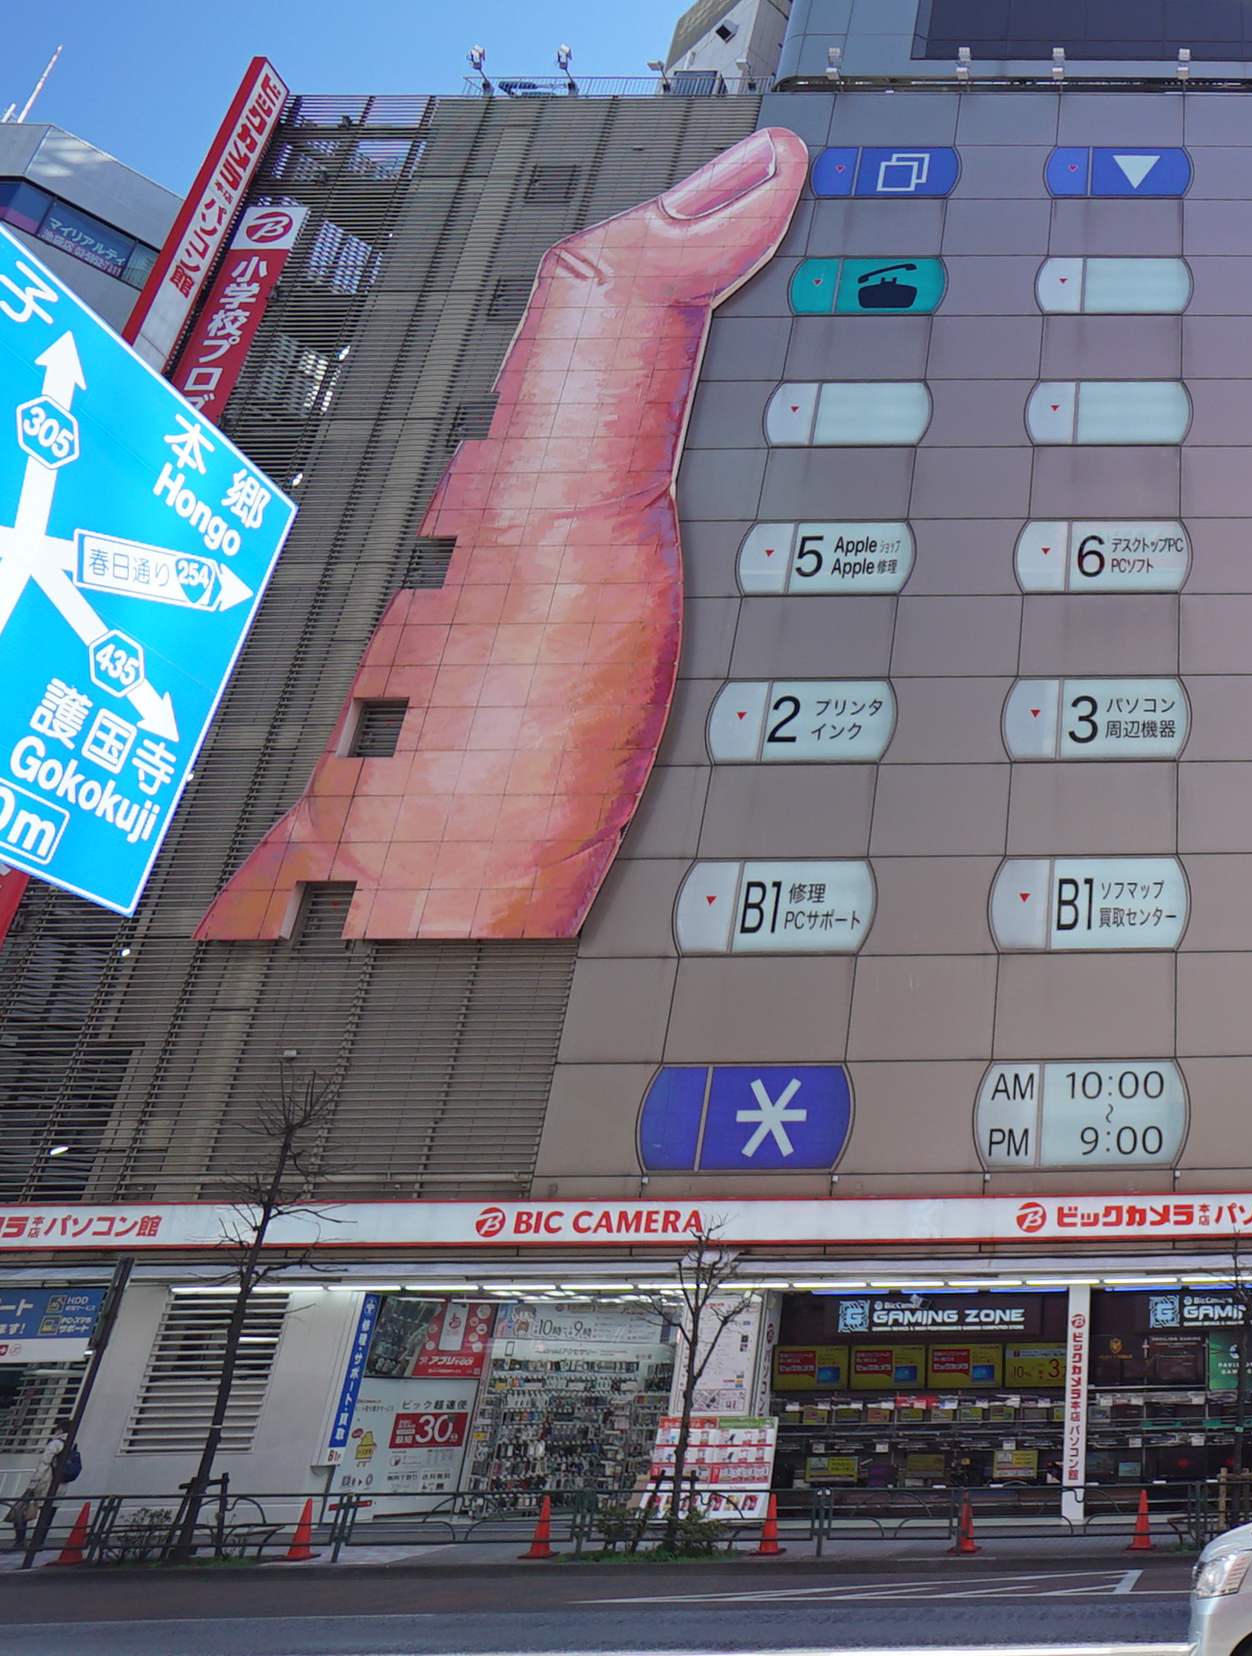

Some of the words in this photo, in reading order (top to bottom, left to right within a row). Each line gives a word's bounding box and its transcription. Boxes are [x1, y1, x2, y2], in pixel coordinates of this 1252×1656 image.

[49, 217, 127, 266] マイリアルティ
[23, 406, 73, 459] 305
[164, 413, 271, 529] 本郷
[153, 462, 241, 556] Hongo
[795, 536, 825, 577] 5
[834, 536, 878, 557] Apple
[1077, 535, 1105, 577] 6
[1111, 538, 1184, 553] デスクトップPC
[89, 549, 170, 588] 春日通り
[177, 560, 210, 589] 254
[831, 558, 875, 579] Apple
[1111, 558, 1154, 574] PCソフト
[95, 644, 140, 685] 435
[766, 696, 800, 743] 2
[816, 698, 883, 717] プリンタ
[1068, 695, 1098, 743] 3
[1106, 698, 1175, 714] パソコン
[30, 678, 177, 796] 護国寺
[811, 723, 862, 741] インク
[1105, 720, 1176, 739] 周辺機器
[10, 736, 160, 843] Gokokuji
[788, 883, 826, 904] 修理
[1056, 878, 1094, 931] B1
[1101, 880, 1165, 900] ソフマップ
[739, 881, 782, 934] B1
[784, 909, 861, 930] PCサポート
[1099, 906, 1177, 928] 買取センター
[991, 1073, 1035, 1101] AM
[1066, 1071, 1164, 1099] 10:00
[988, 1128, 1029, 1157] PM
[1080, 1126, 1163, 1155] 9:00
[513, 1211, 565, 1234] BIC
[572, 1210, 703, 1234] CAMERA
[67, 1296, 89, 1305] HDD
[872, 1309, 958, 1325] GAMING
[964, 1309, 1025, 1324] ZONE
